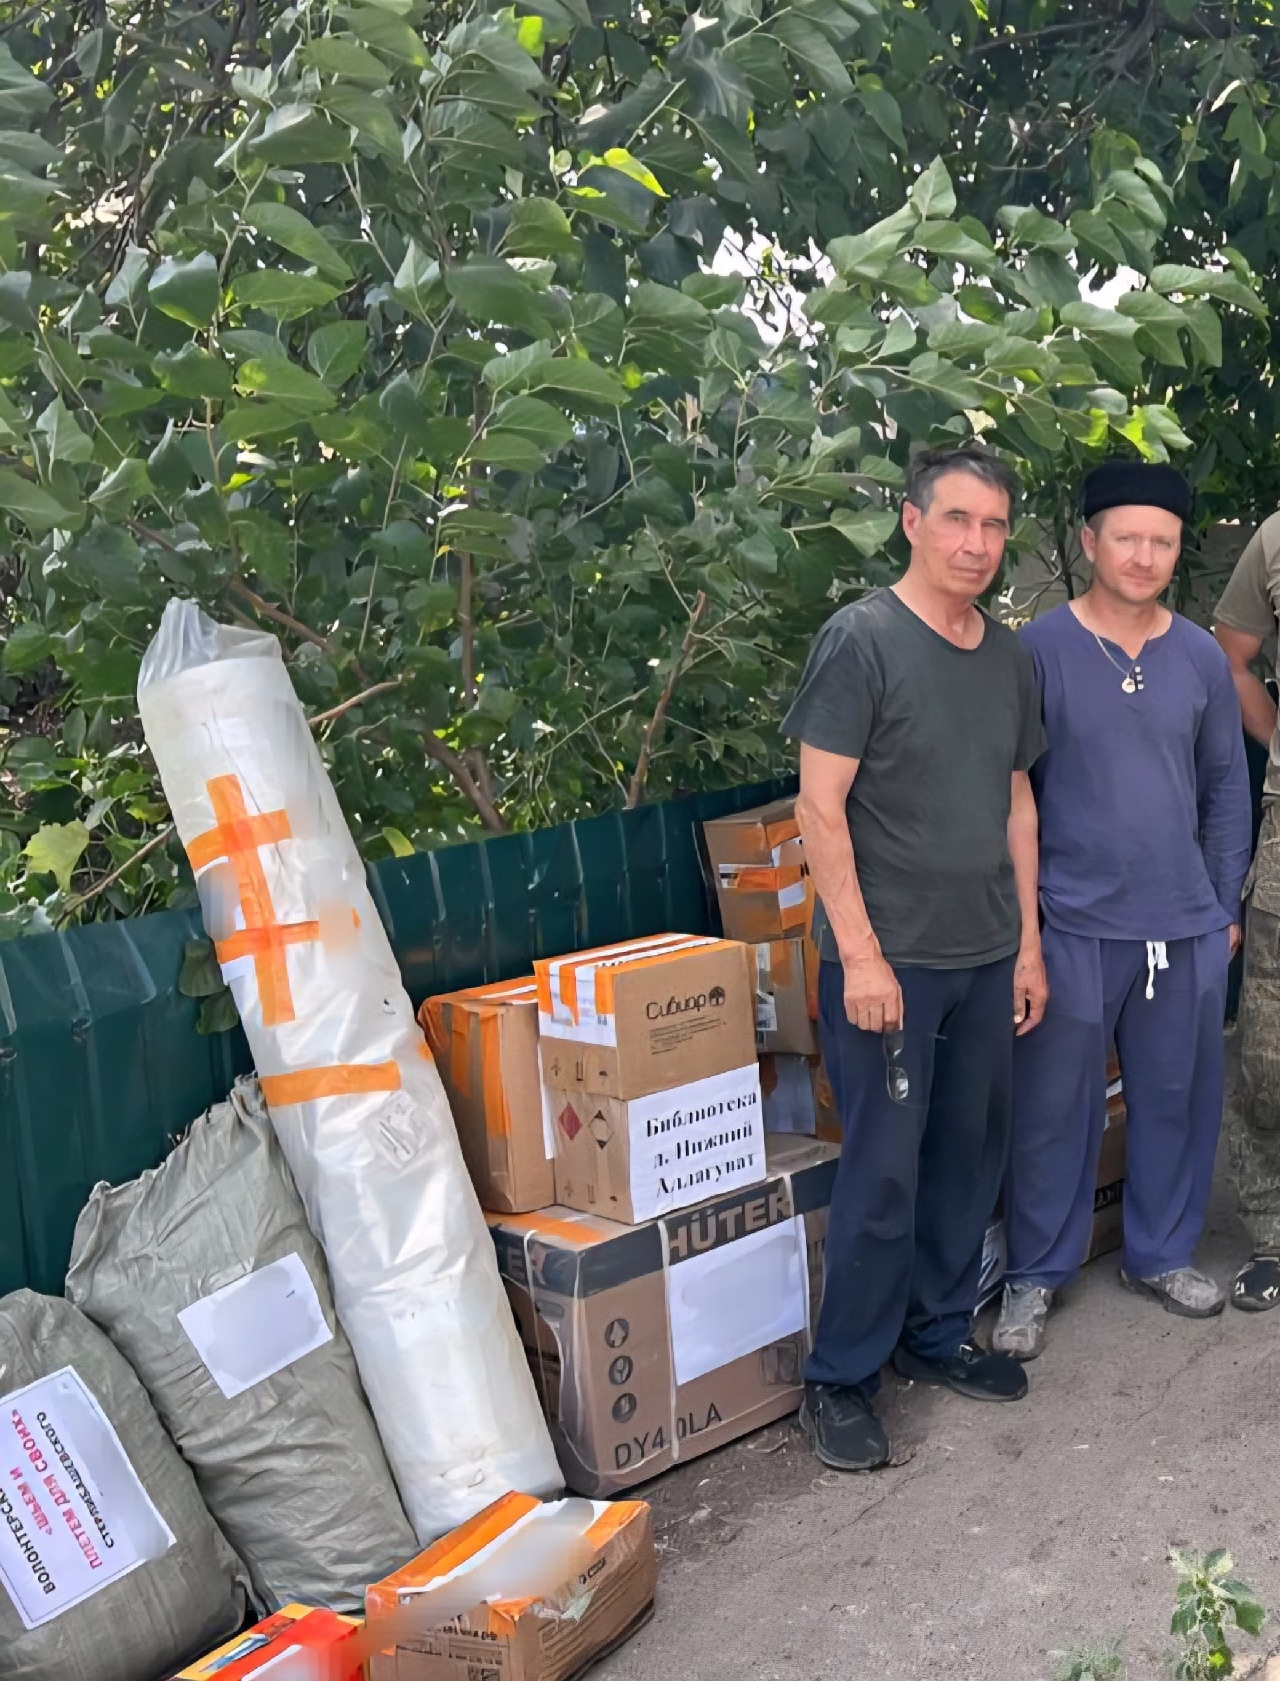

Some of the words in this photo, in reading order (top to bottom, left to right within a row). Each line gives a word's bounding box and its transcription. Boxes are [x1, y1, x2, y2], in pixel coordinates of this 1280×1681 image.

[646, 1091, 757, 1138] Библиотека
[676, 1121, 753, 1160] Нижний
[669, 1191, 790, 1258] HÜTER
[10, 1466, 23, 1481] И
[43, 1474, 71, 1508] ДЛЯ
[62, 1507, 103, 1570] ПЛЕТЕМ
